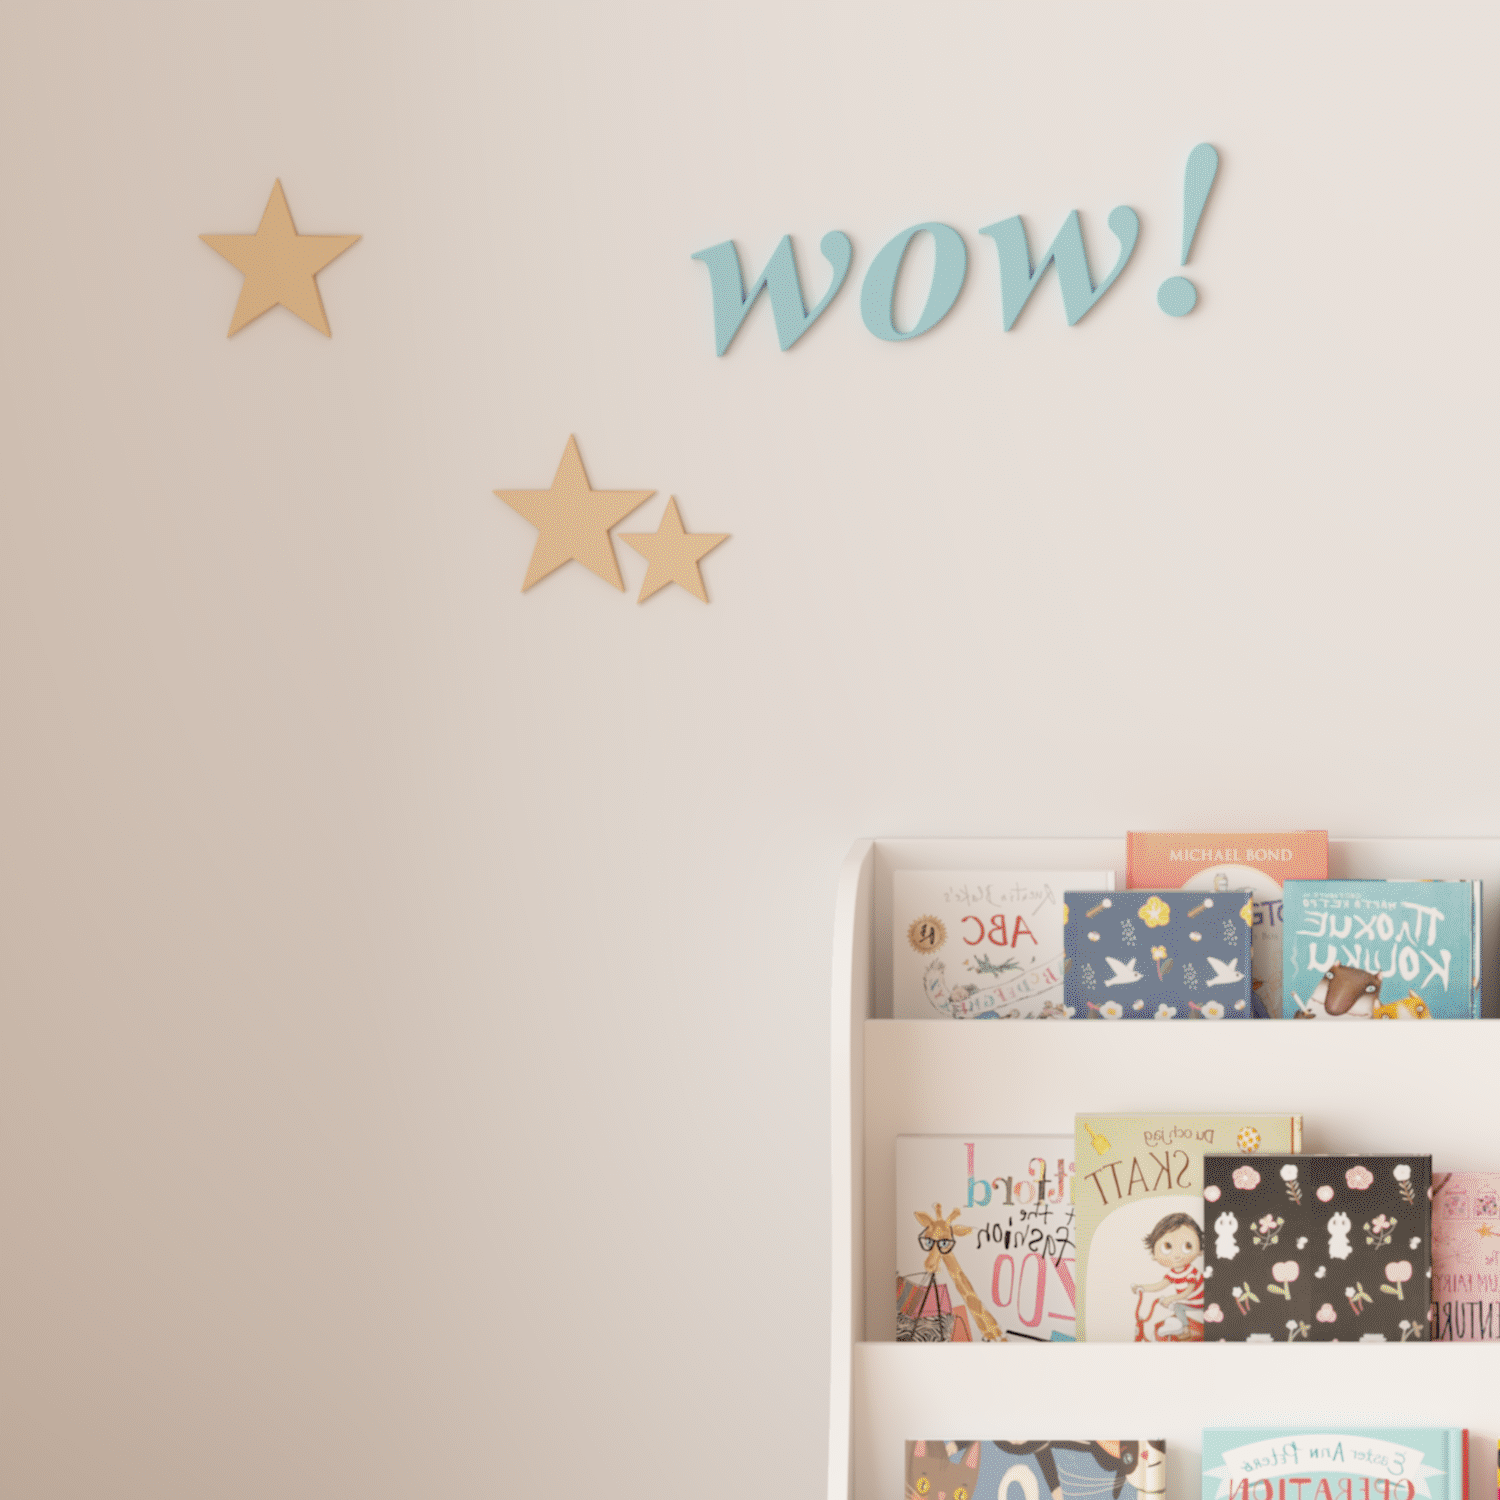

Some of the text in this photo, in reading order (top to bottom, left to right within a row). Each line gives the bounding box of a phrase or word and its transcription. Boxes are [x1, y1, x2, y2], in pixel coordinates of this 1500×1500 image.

[690, 142, 1220, 358] wow!
[1169, 849, 1294, 861] MICHAEL BOND
